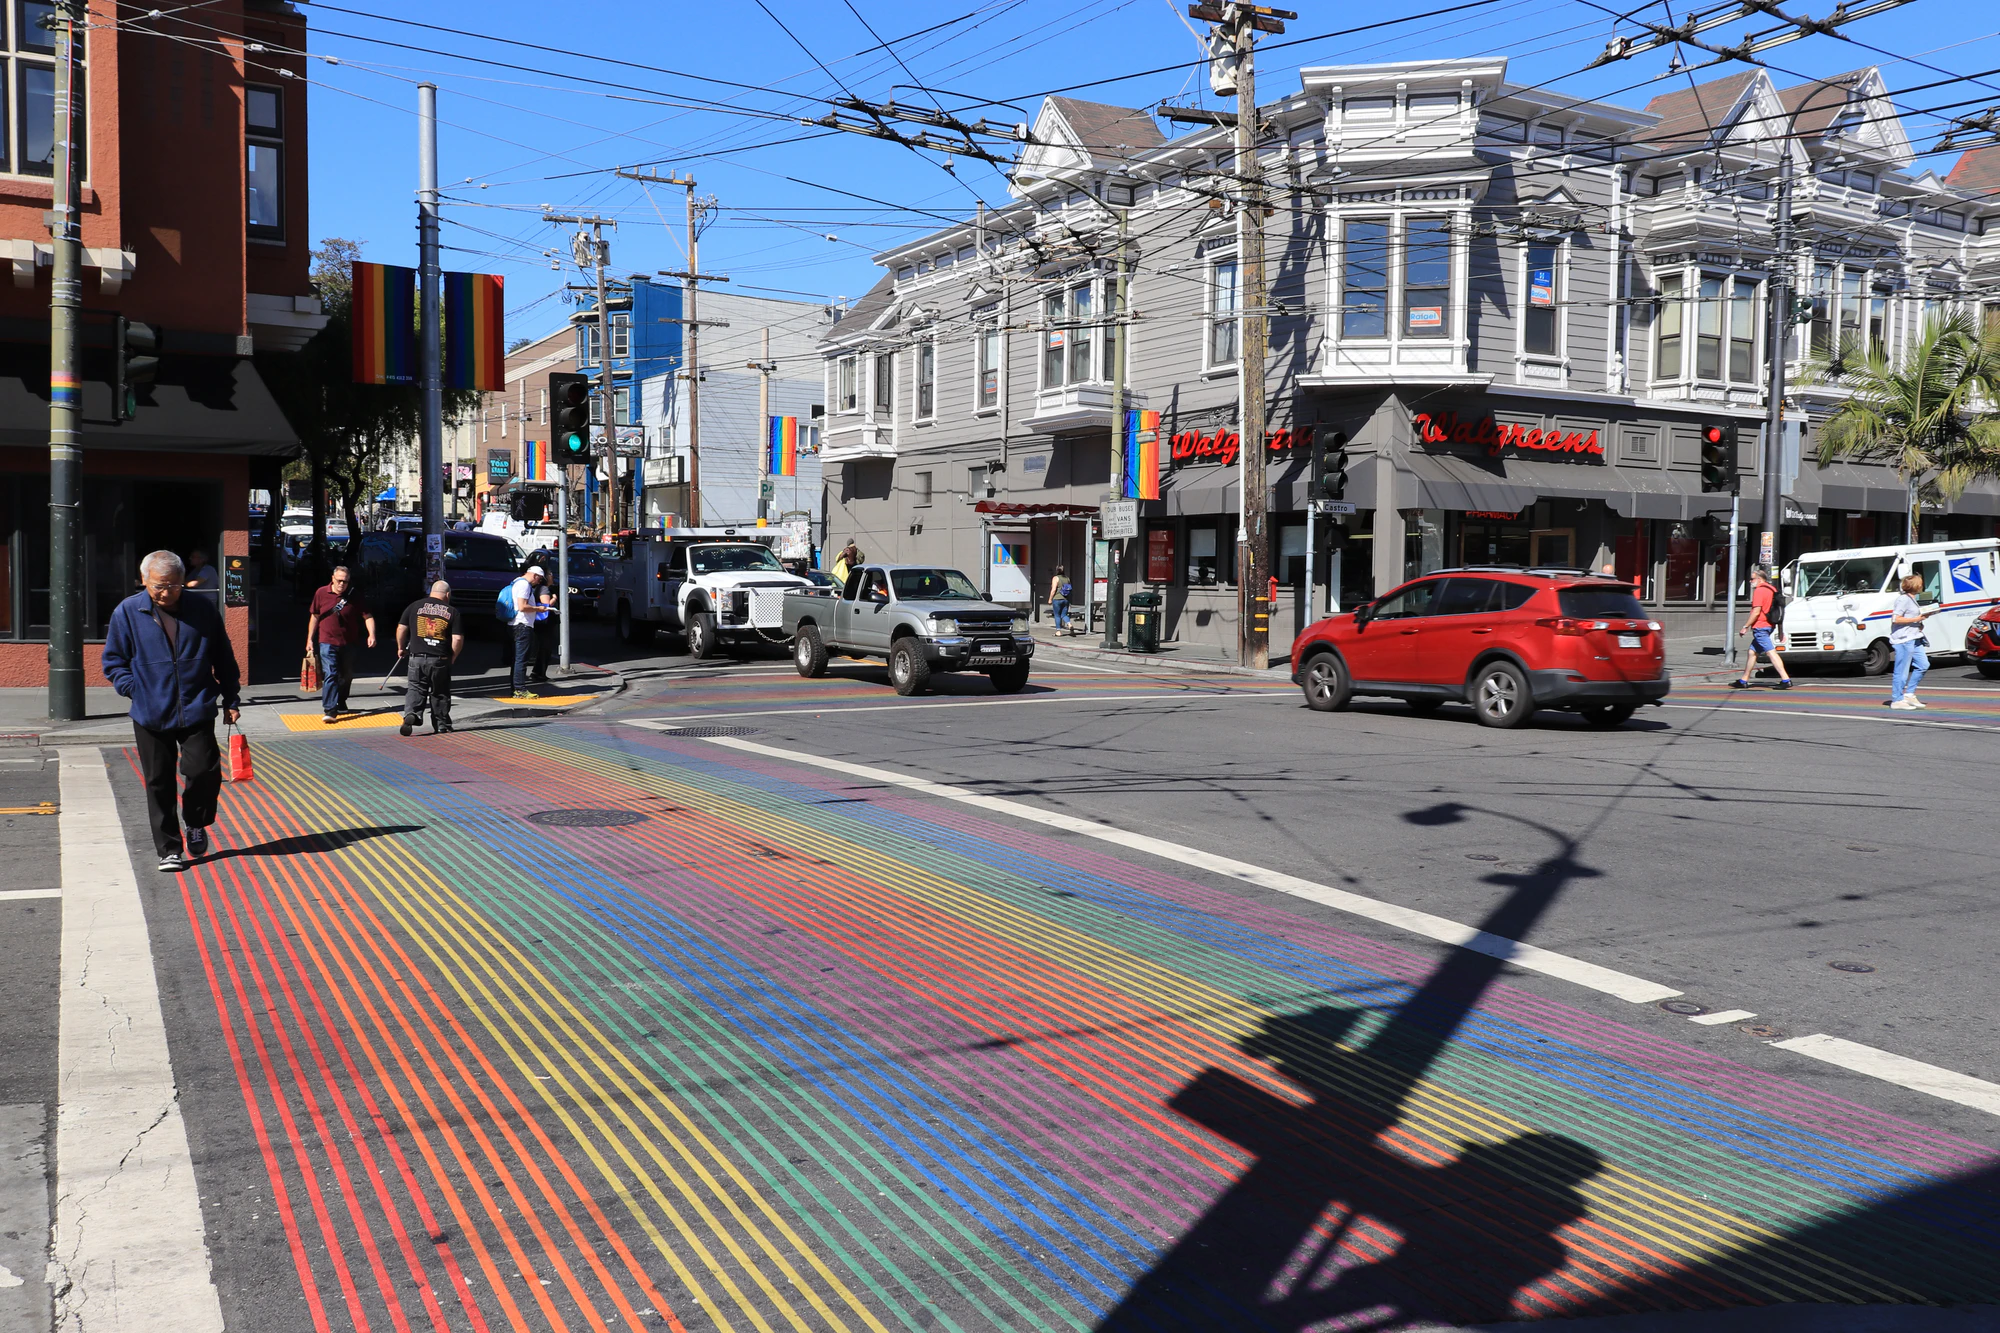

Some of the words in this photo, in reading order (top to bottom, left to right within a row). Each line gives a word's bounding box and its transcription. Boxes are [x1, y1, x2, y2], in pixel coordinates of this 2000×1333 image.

[1410, 312, 1437, 320] Rafael
[1412, 411, 1605, 457] Walgreens
[589, 436, 642, 446] COE40
[1324, 504, 1348, 512] Castro
[1465, 510, 1519, 521] PHARMACY
[423, 602, 449, 612] BLACK
